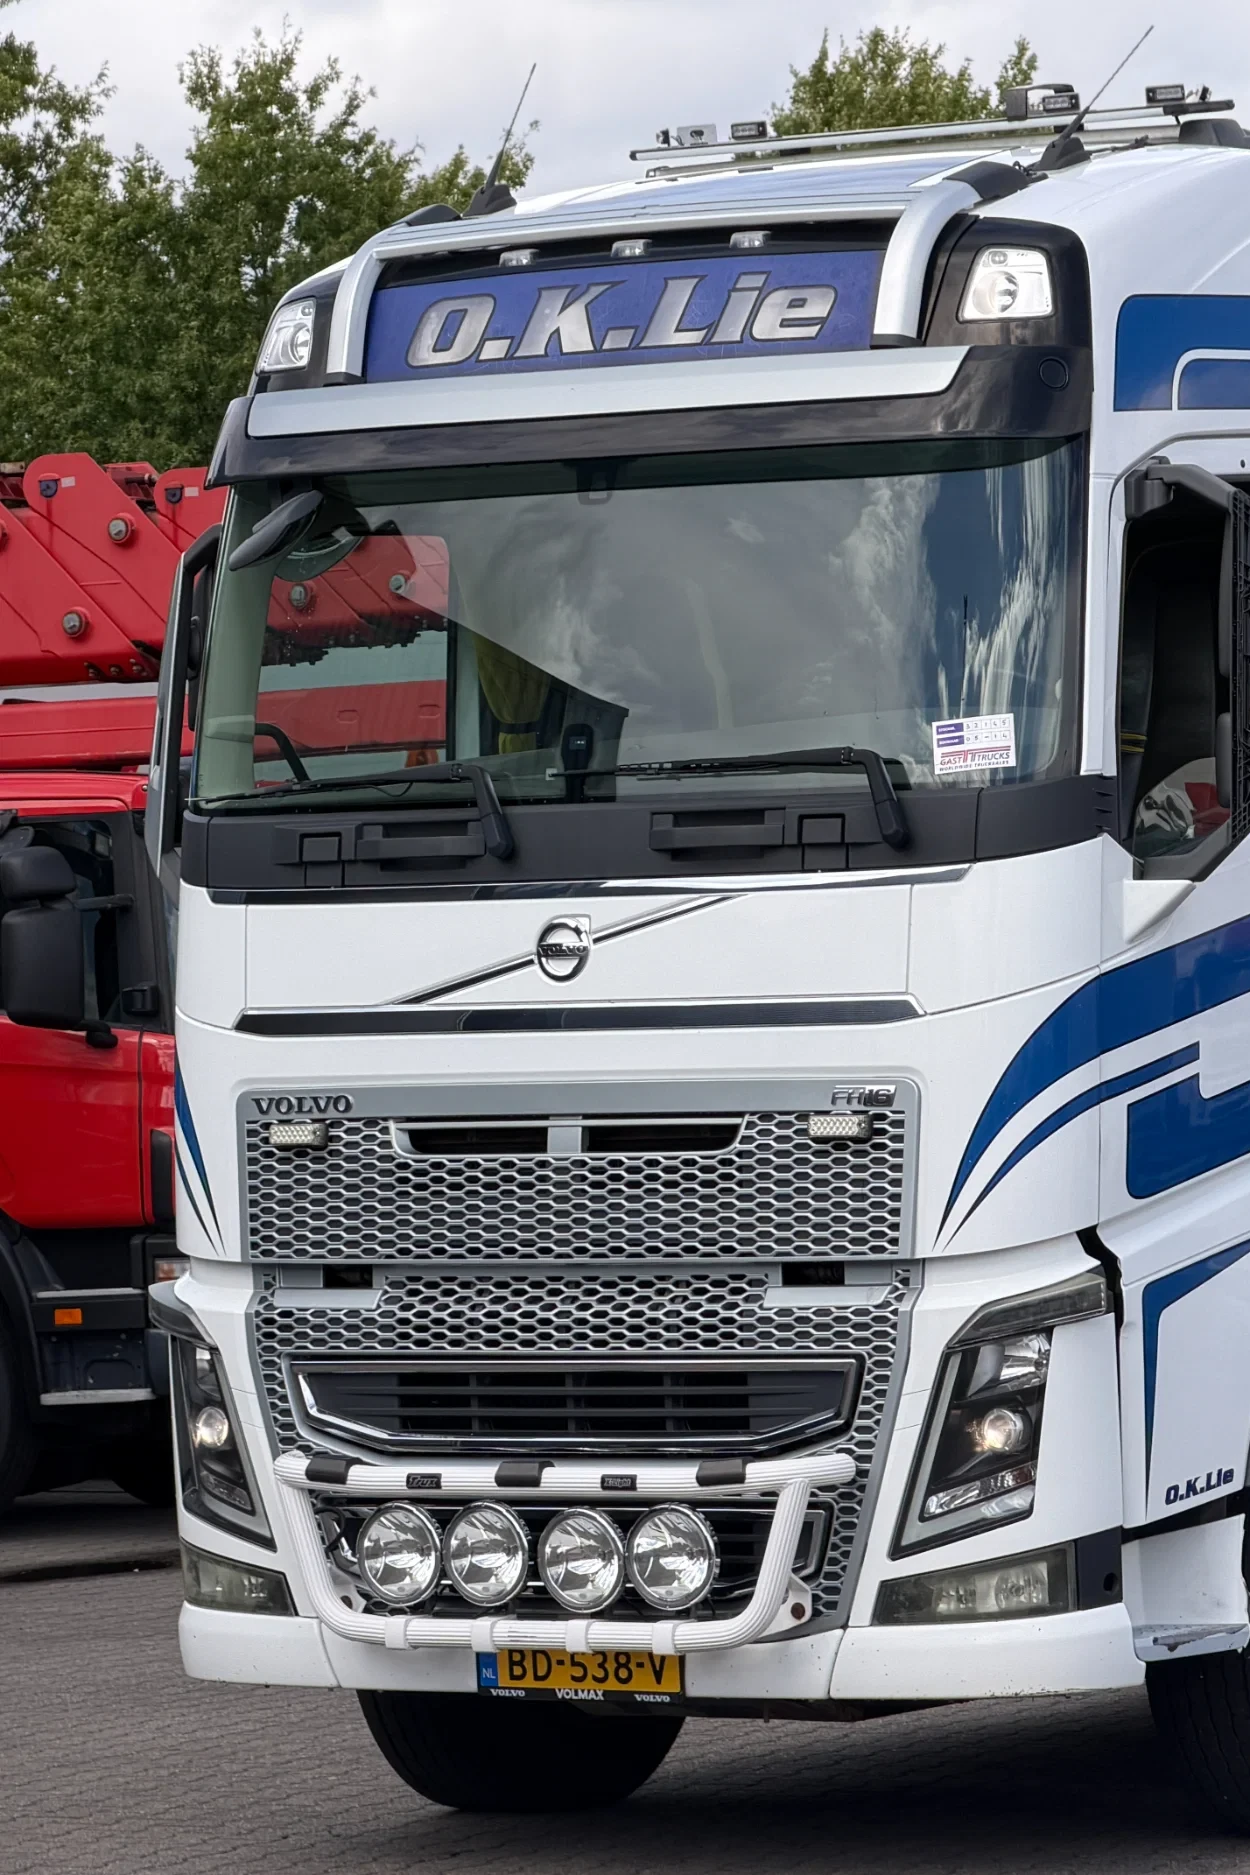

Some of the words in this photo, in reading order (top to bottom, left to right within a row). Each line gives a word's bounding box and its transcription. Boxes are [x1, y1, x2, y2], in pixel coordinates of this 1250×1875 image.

[406, 271, 838, 370] O.K.Lie
[538, 944, 589, 956] VOLVO
[251, 1094, 353, 1116] VOLVO
[831, 1086, 896, 1107] FH16
[481, 1667, 496, 1679] NL
[507, 1649, 667, 1686] BD-538-V
[489, 1688, 526, 1698] VOLVO
[554, 1688, 605, 1701] VOLMAX
[633, 1693, 671, 1703] VOLVO
